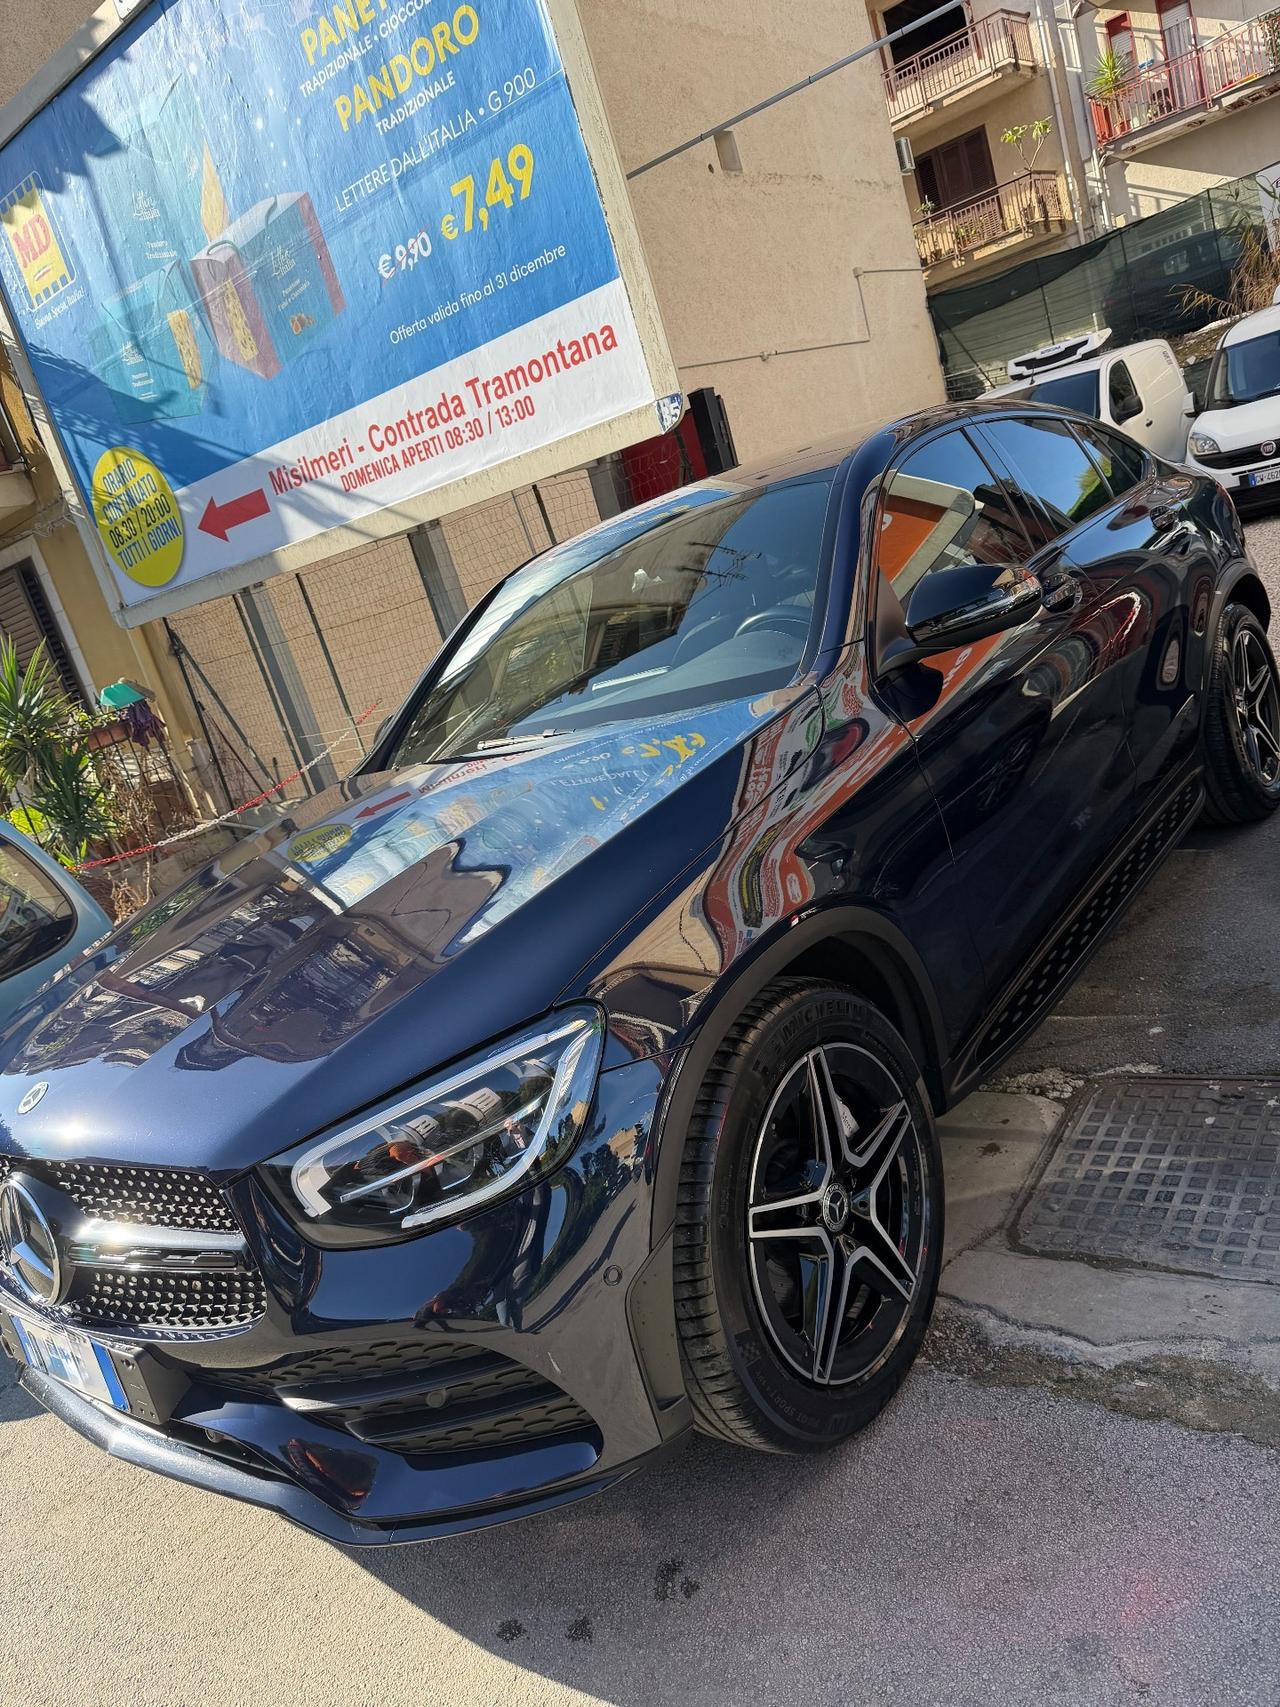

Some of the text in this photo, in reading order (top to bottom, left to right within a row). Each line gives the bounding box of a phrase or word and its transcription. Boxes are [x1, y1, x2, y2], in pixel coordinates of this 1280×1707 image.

[300, 0, 387, 66] PANE
[300, 35, 373, 98] TRADIZIONALE
[335, 4, 479, 133] PANDORO
[375, 70, 456, 136] TRADIZIONALE
[335, 67, 536, 213] LETTERE DALL'ITALIA G 900
[12, 213, 51, 269] MD
[390, 245, 566, 344] Offerta valida fino al 31 dicembre
[268, 437, 355, 496] Misilmeri
[368, 392, 466, 453] Contrada
[464, 324, 618, 409] Tramontana
[102, 458, 137, 494] ORARIO
[340, 454, 402, 493] DOMENICA
[401, 434, 445, 469] APERTI
[446, 416, 484, 450] 08:30
[494, 394, 536, 429] 13:00
[102, 472, 158, 525] CONTINUATO
[108, 516, 138, 549] 08:30
[140, 492, 172, 528] 20:00
[117, 539, 146, 571] TUTTI
[147, 516, 183, 552] GIORNI
